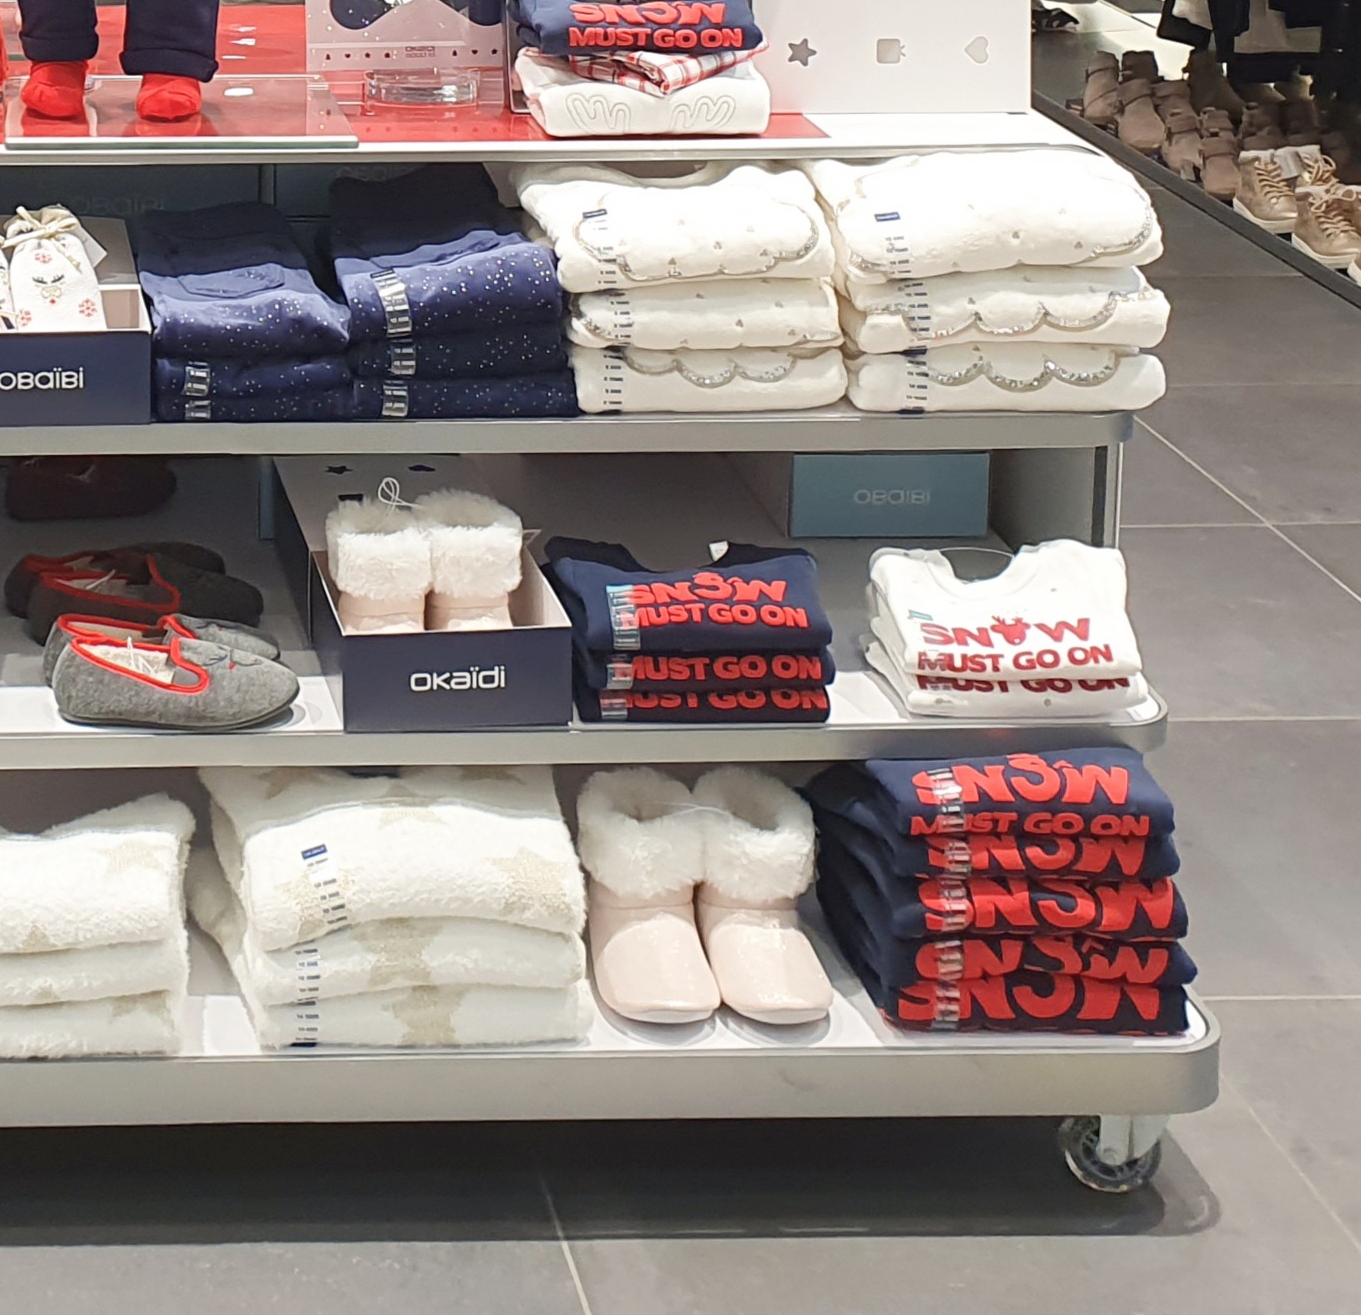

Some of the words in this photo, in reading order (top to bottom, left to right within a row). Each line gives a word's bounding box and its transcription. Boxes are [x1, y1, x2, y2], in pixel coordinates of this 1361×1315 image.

[569, 27, 651, 47] MUST
[652, 28, 698, 49] GO
[700, 28, 743, 48] ON
[619, 603, 705, 630] MUST
[708, 605, 758, 624] GO
[760, 604, 809, 628] ON
[614, 655, 710, 681] MUST
[712, 655, 768, 681] GO
[771, 654, 823, 681] ON
[917, 651, 1005, 674] MUST
[1012, 648, 1061, 671] GO
[1067, 643, 1115, 666] ON
[707, 688, 767, 710] GO
[770, 687, 829, 710] ON
[1023, 811, 1086, 836] GO
[1090, 814, 1150, 836] ON
